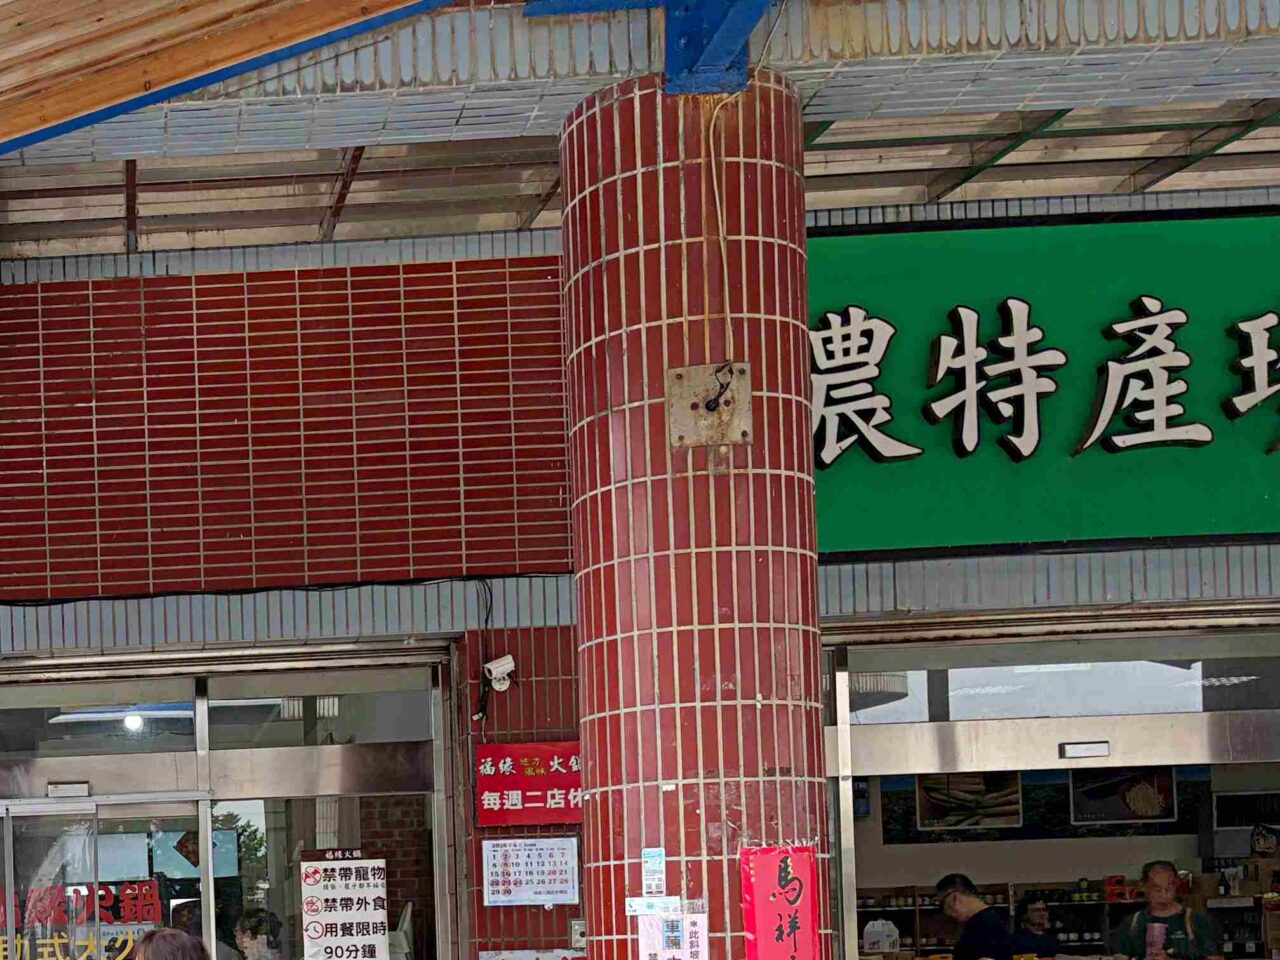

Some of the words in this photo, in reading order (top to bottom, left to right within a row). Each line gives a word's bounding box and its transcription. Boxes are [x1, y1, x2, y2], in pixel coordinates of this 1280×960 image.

[481, 787, 582, 811] 每週二店休
[322, 866, 386, 882] 禁帶寵物
[323, 895, 387, 912] 禁帶外食
[324, 921, 387, 937] 用餐限時
[324, 944, 377, 959] 90分鐘
